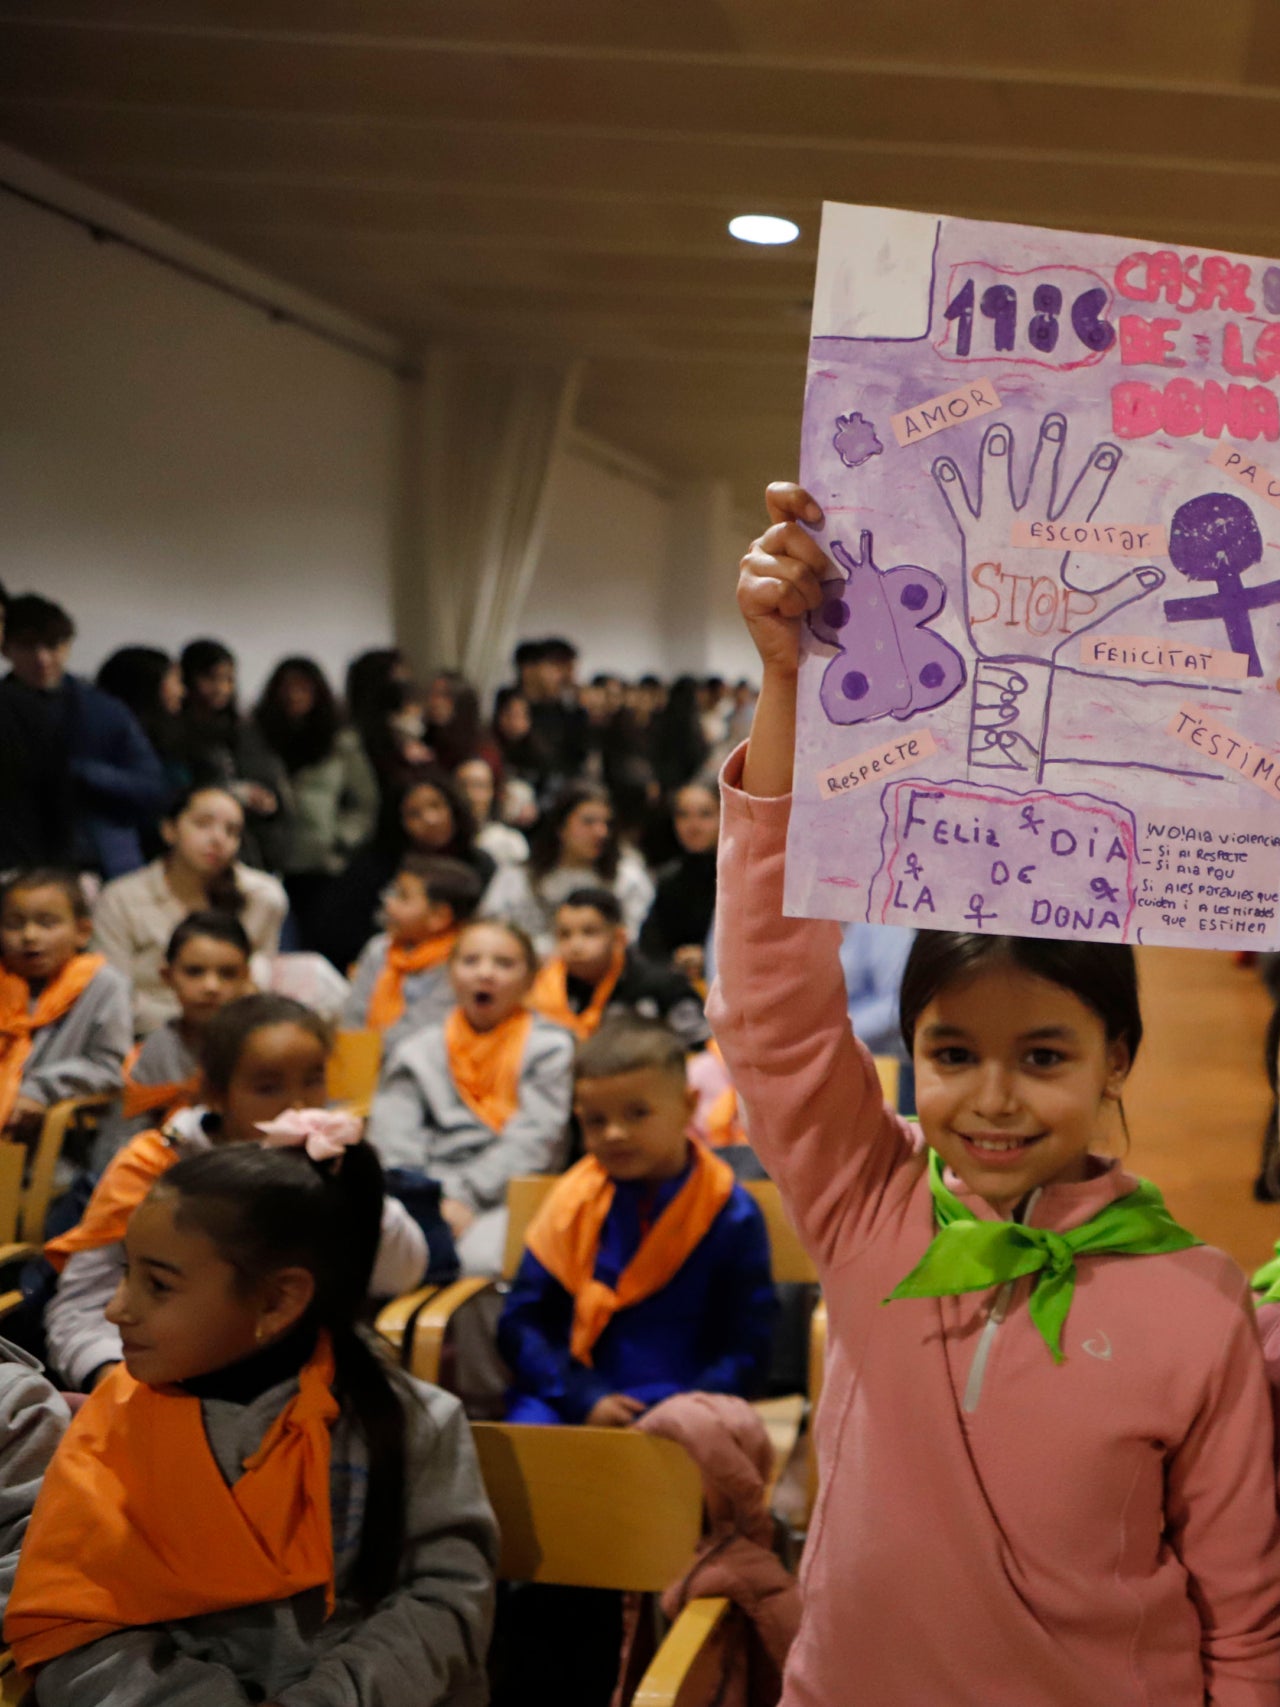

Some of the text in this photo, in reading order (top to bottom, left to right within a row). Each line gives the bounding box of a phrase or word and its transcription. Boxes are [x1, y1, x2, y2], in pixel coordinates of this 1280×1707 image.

[1114, 250, 1256, 313] CASAL
[944, 278, 1116, 357] 1986
[905, 389, 992, 438] AMOR
[1111, 377, 1280, 443] DONA
[971, 562, 1098, 636] STOP
[991, 860, 1036, 886] DE
[893, 880, 1120, 930] LA DONA
